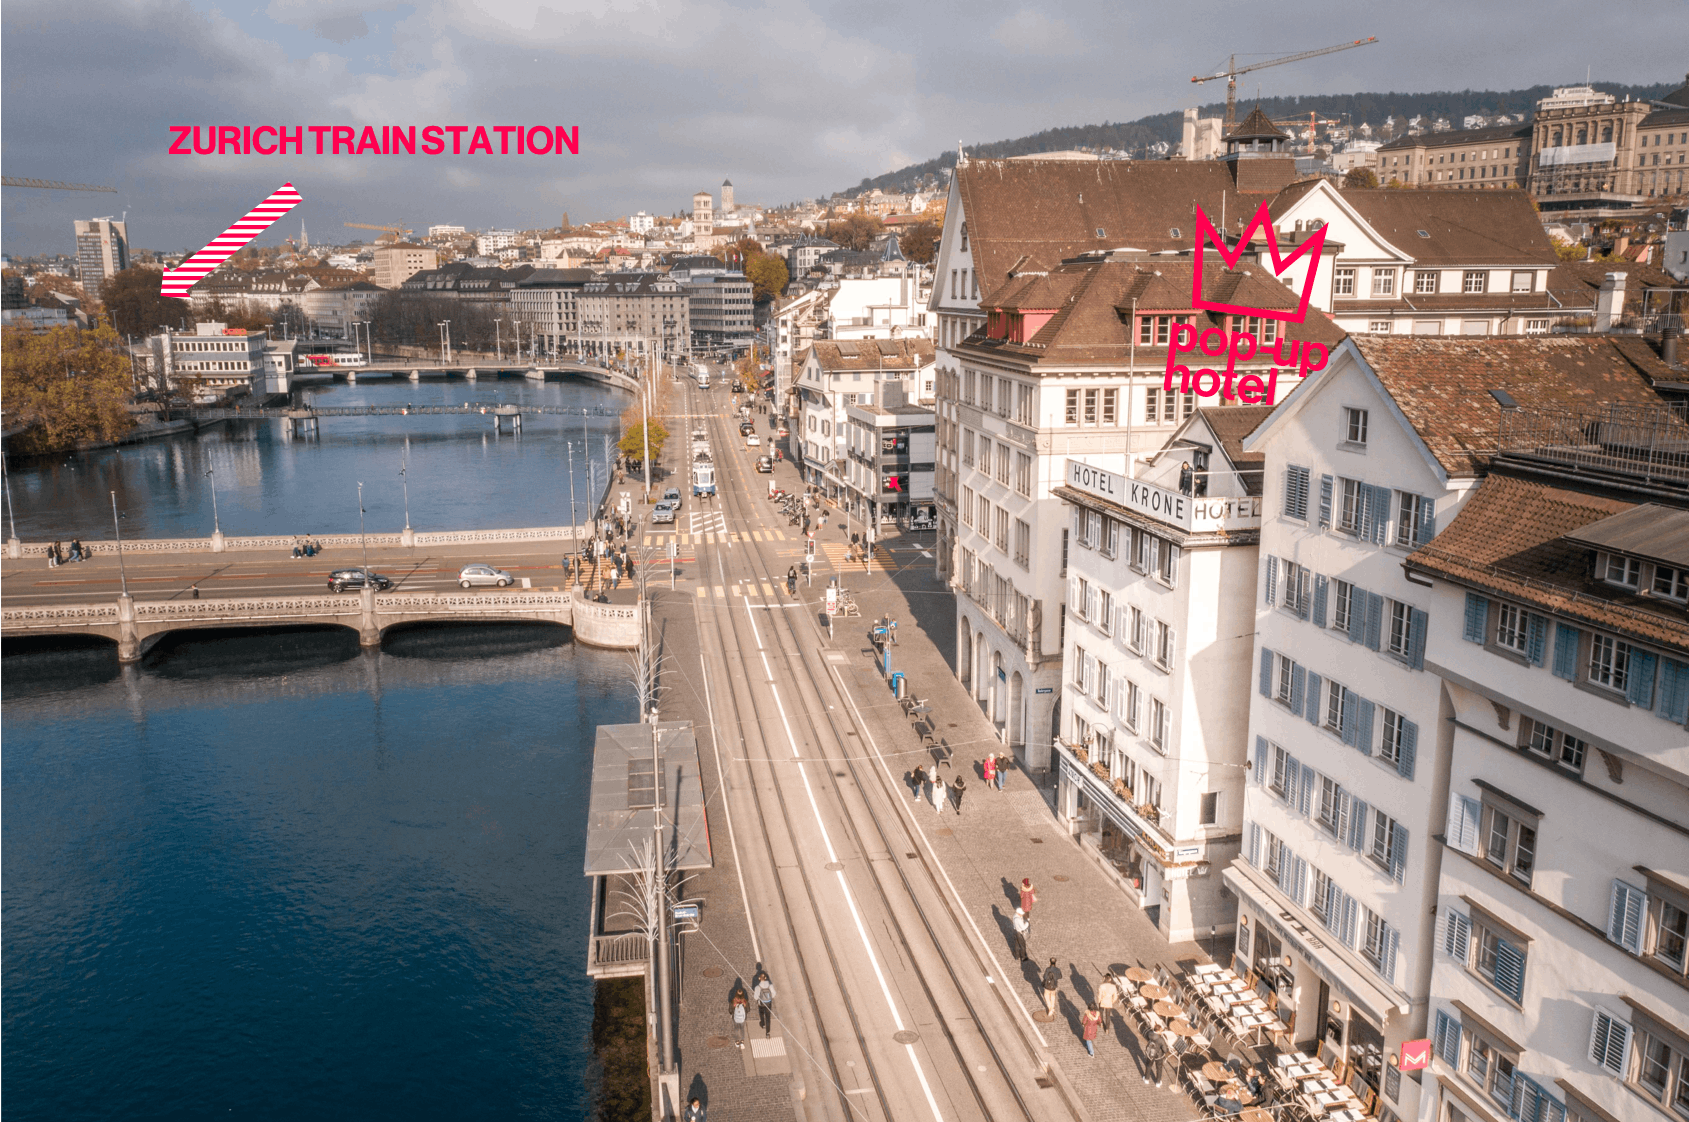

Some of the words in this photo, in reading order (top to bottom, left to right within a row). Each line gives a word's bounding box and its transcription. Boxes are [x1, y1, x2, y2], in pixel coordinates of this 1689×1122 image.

[1073, 464, 1114, 495] HOTEL
[1131, 482, 1184, 520] KRONE
[1195, 500, 1261, 520] HOTEL
